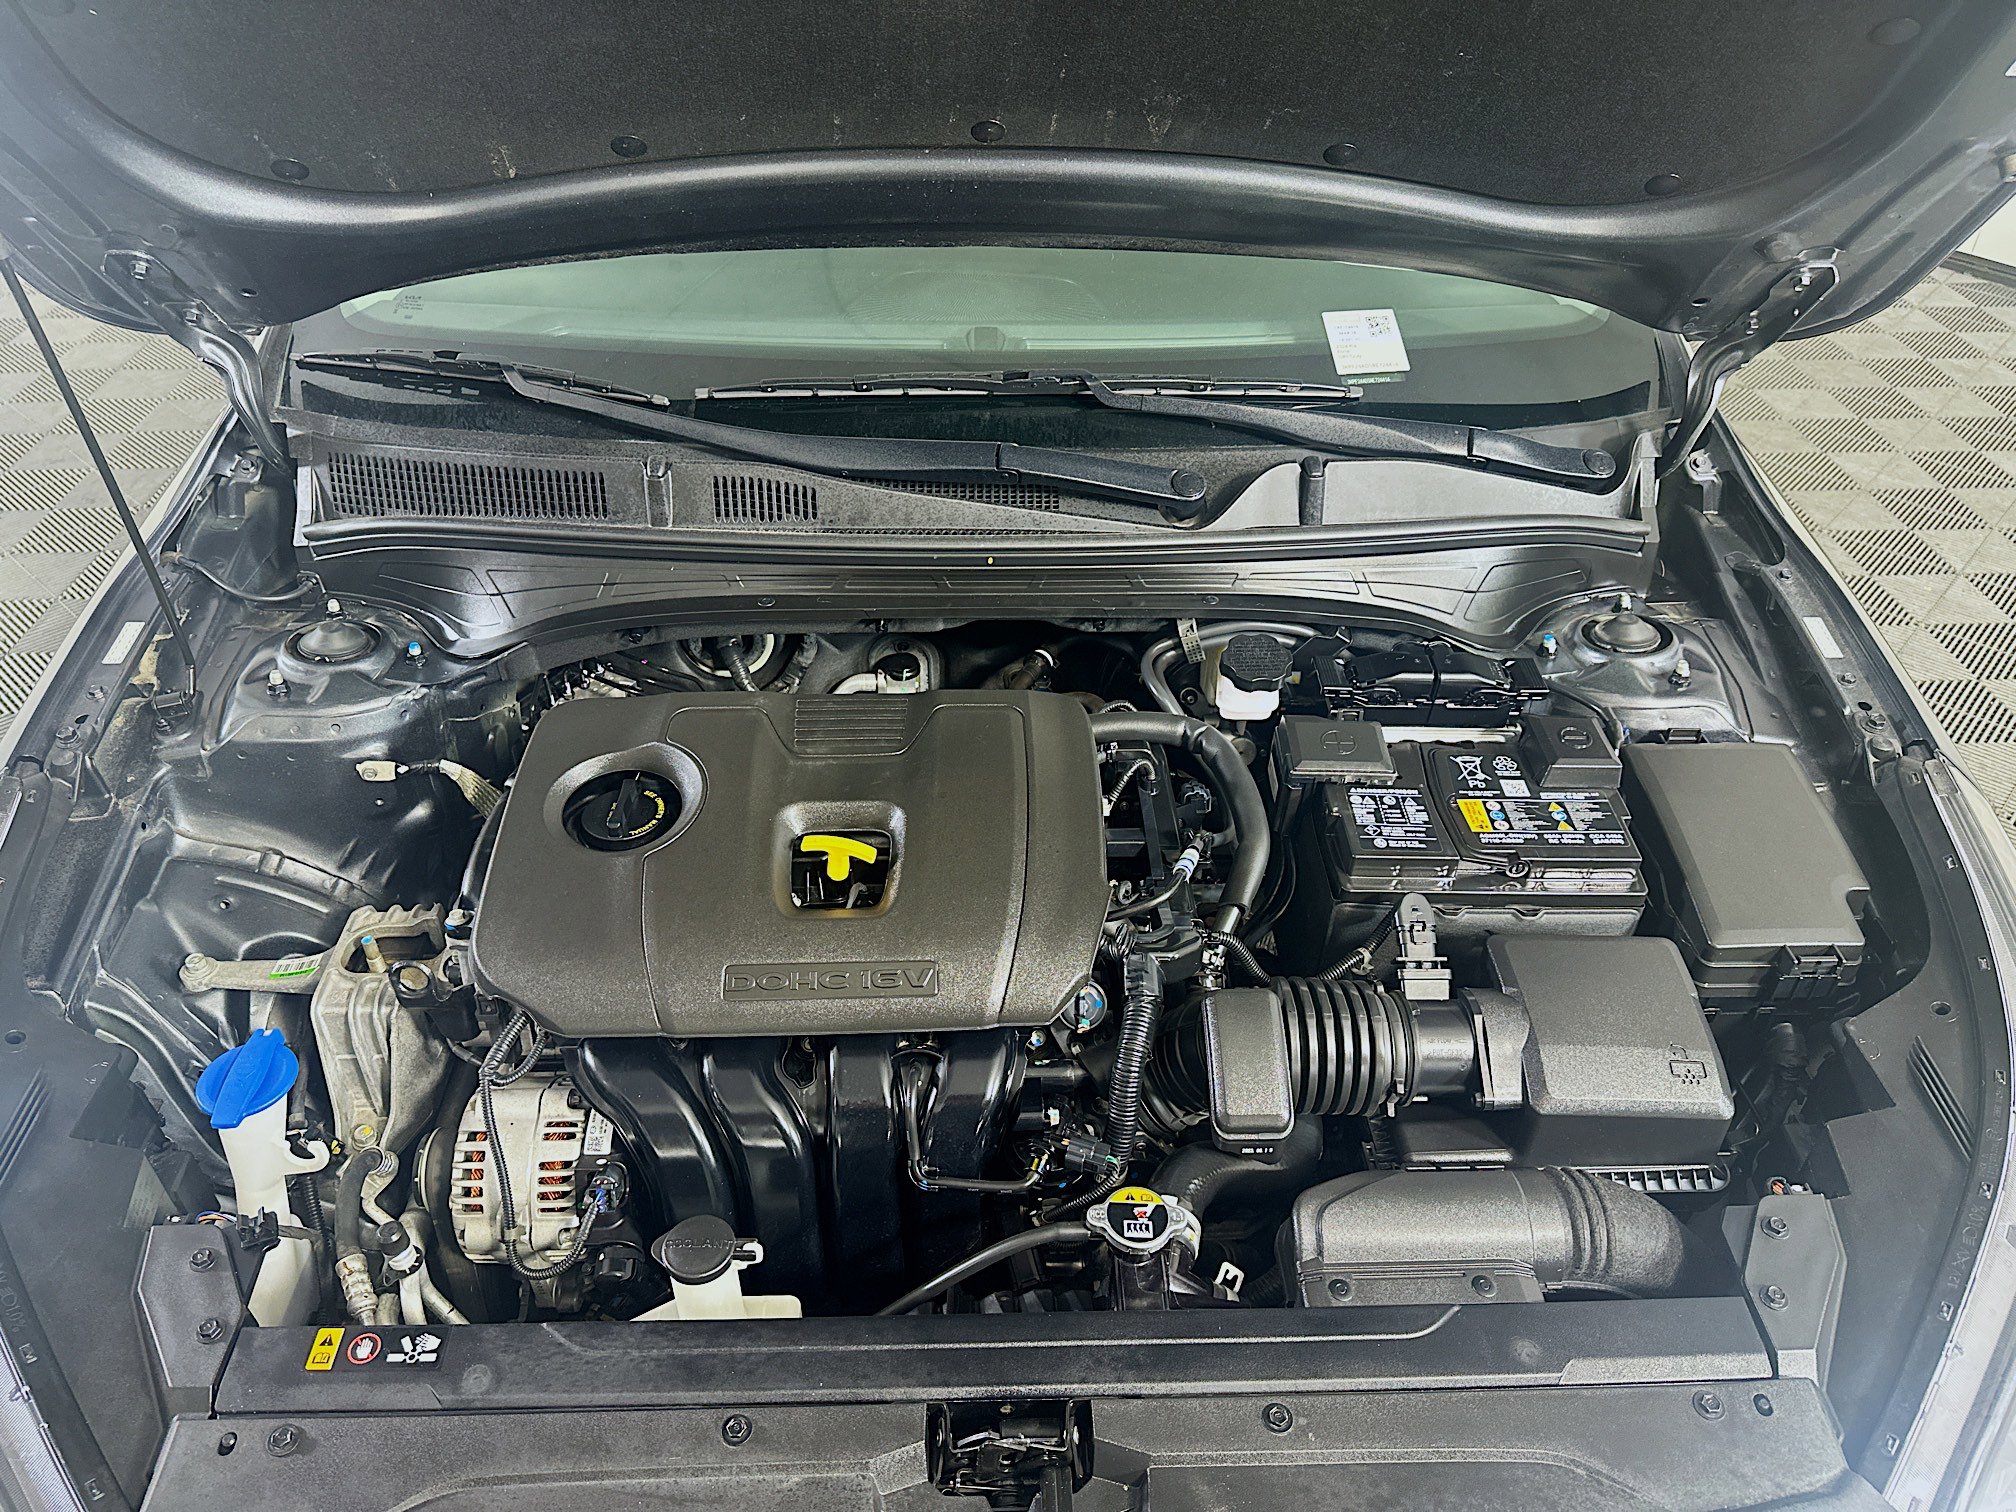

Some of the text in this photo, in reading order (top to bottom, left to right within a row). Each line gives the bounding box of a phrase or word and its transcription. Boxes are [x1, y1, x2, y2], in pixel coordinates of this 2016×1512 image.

[1468, 780, 1486, 789] Pb
[725, 968, 934, 992] DOHC 16V
[664, 1239, 735, 1250] COOLANT
